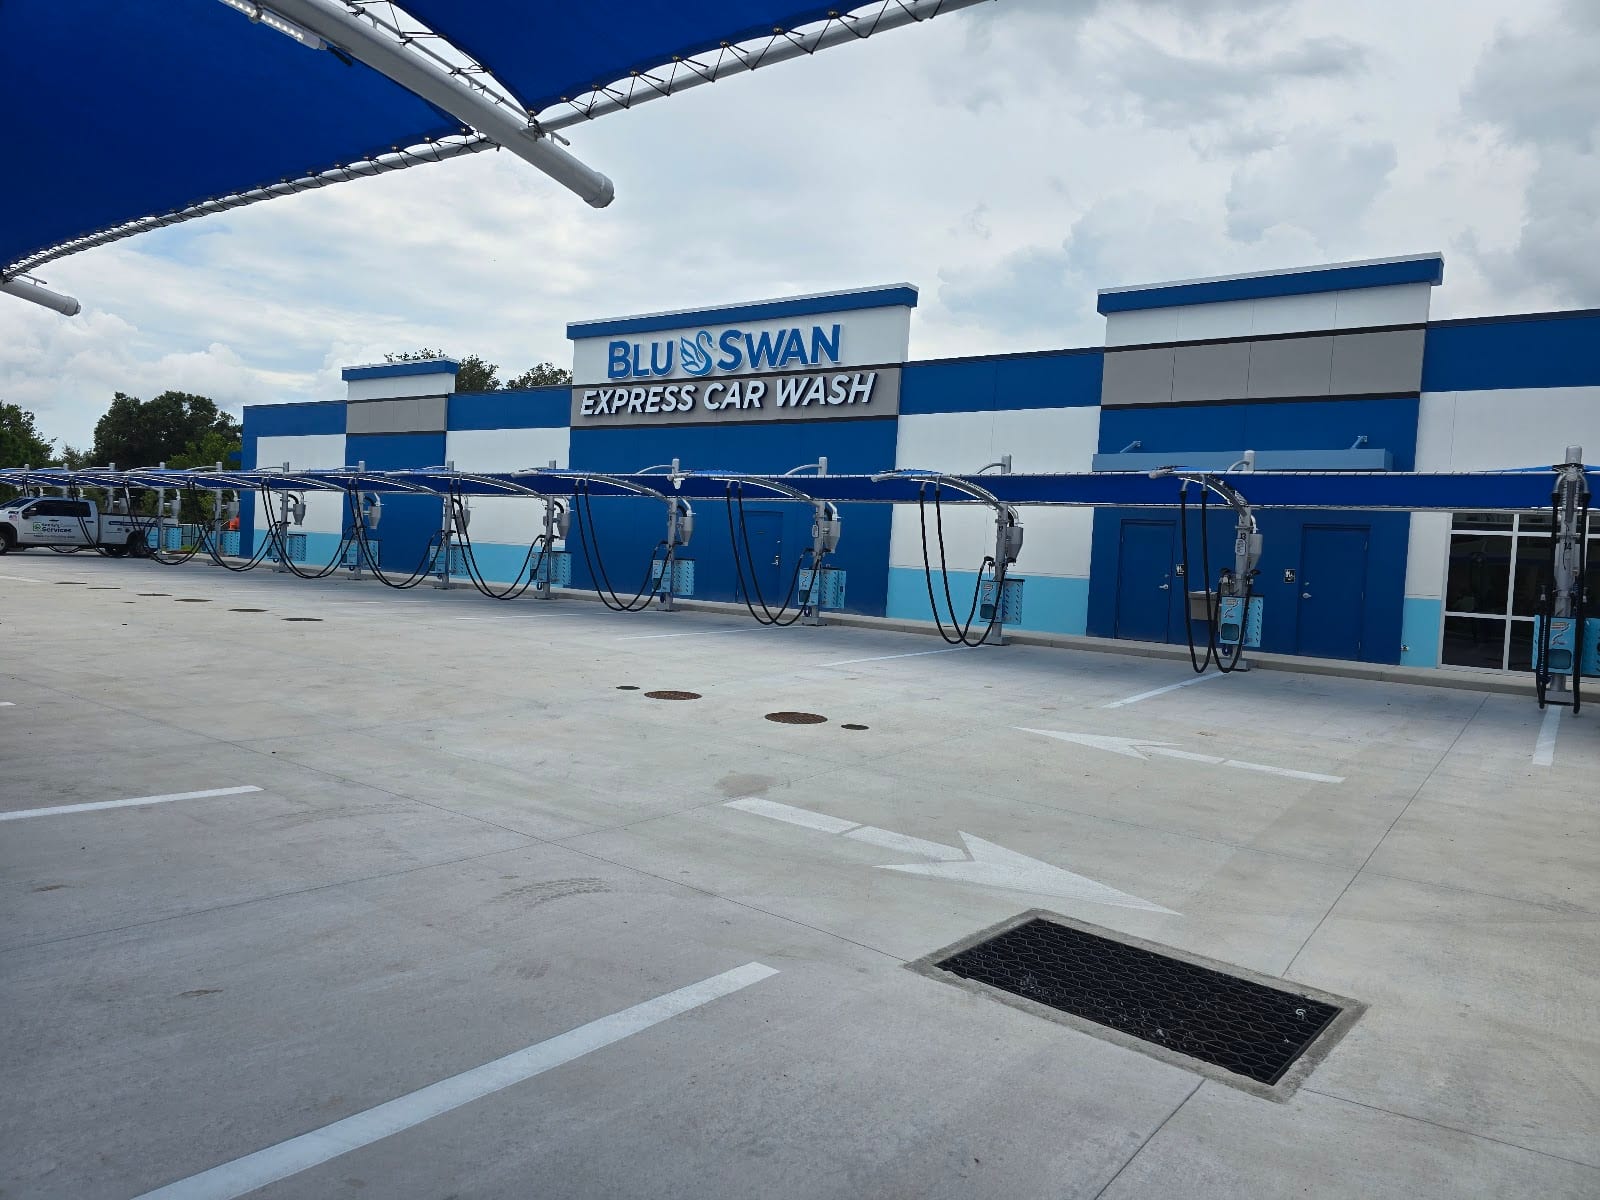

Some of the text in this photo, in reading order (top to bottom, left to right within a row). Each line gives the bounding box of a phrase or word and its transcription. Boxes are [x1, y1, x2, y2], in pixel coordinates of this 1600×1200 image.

[607, 324, 840, 378] BLU SWAN
[580, 372, 877, 415] EXPRESS CAR WASH
